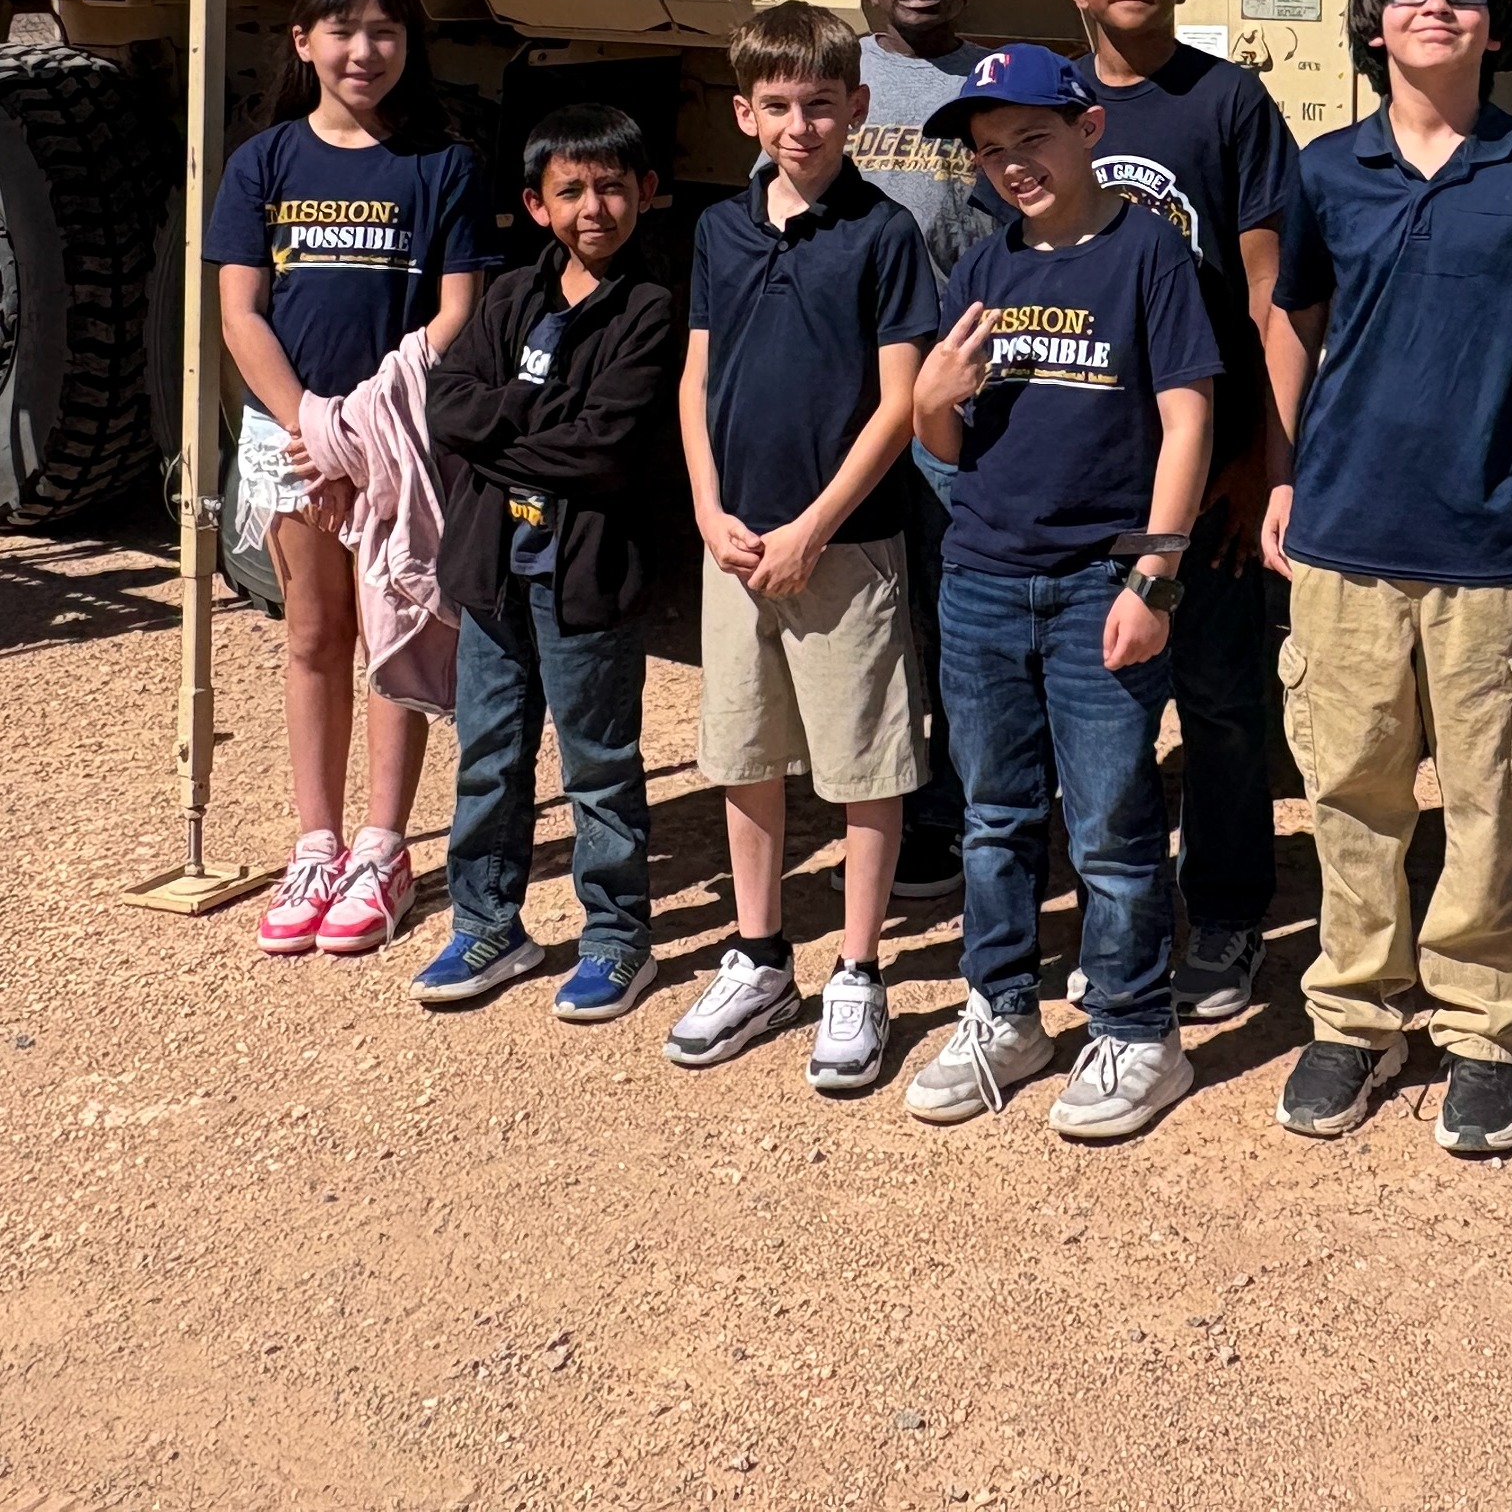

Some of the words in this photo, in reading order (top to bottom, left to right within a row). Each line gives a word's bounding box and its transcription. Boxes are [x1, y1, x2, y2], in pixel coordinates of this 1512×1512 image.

[975, 53, 1011, 86] T
[1302, 101, 1327, 121] KIT
[1113, 164, 1165, 191] GRADE
[290, 225, 412, 252] POSSIBLE
